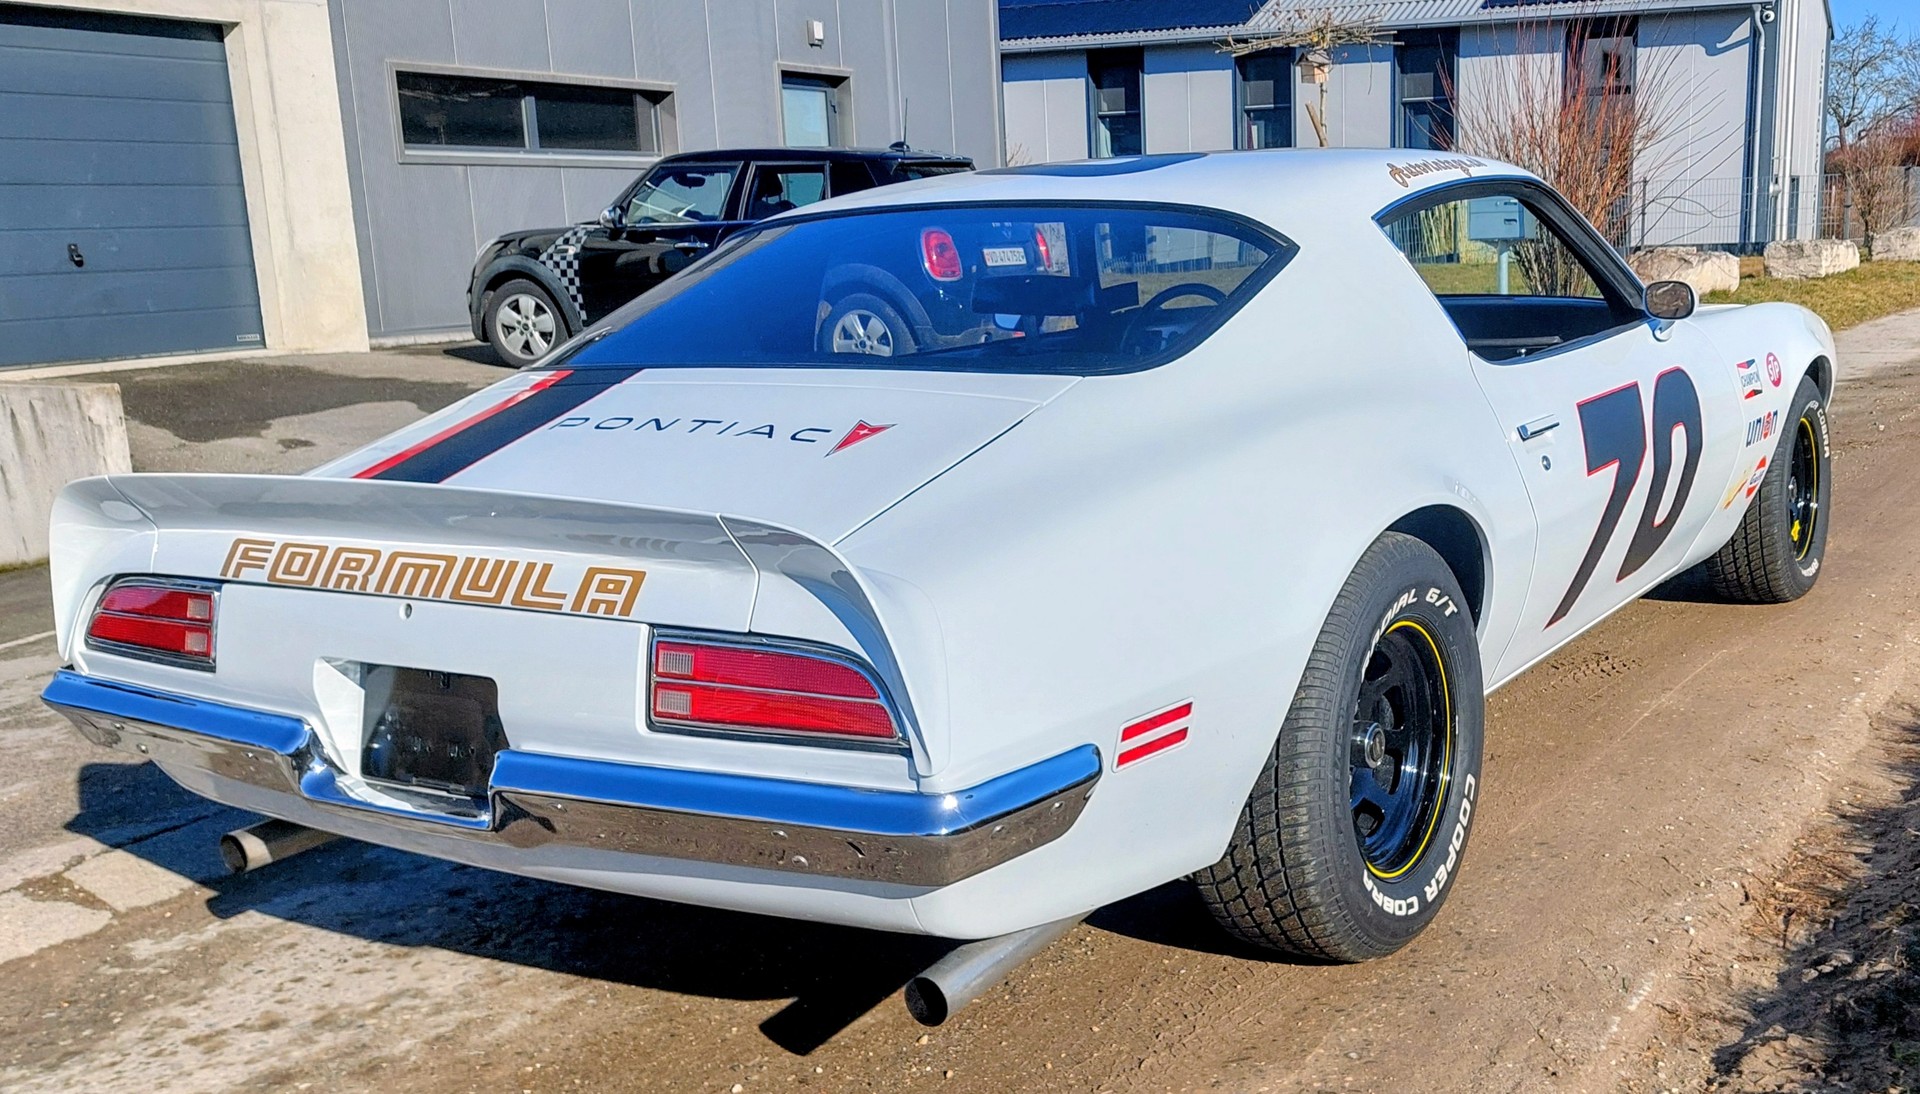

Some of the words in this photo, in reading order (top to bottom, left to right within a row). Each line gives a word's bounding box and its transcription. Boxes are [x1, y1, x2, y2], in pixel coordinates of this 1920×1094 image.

[549, 416, 833, 443] PONTIAC
[1543, 366, 1703, 632] 70
[219, 537, 647, 617] FORMULA
[1425, 587, 1458, 617] G/T
[1424, 773, 1476, 902] COOPER
[1363, 869, 1419, 916] COBRA
